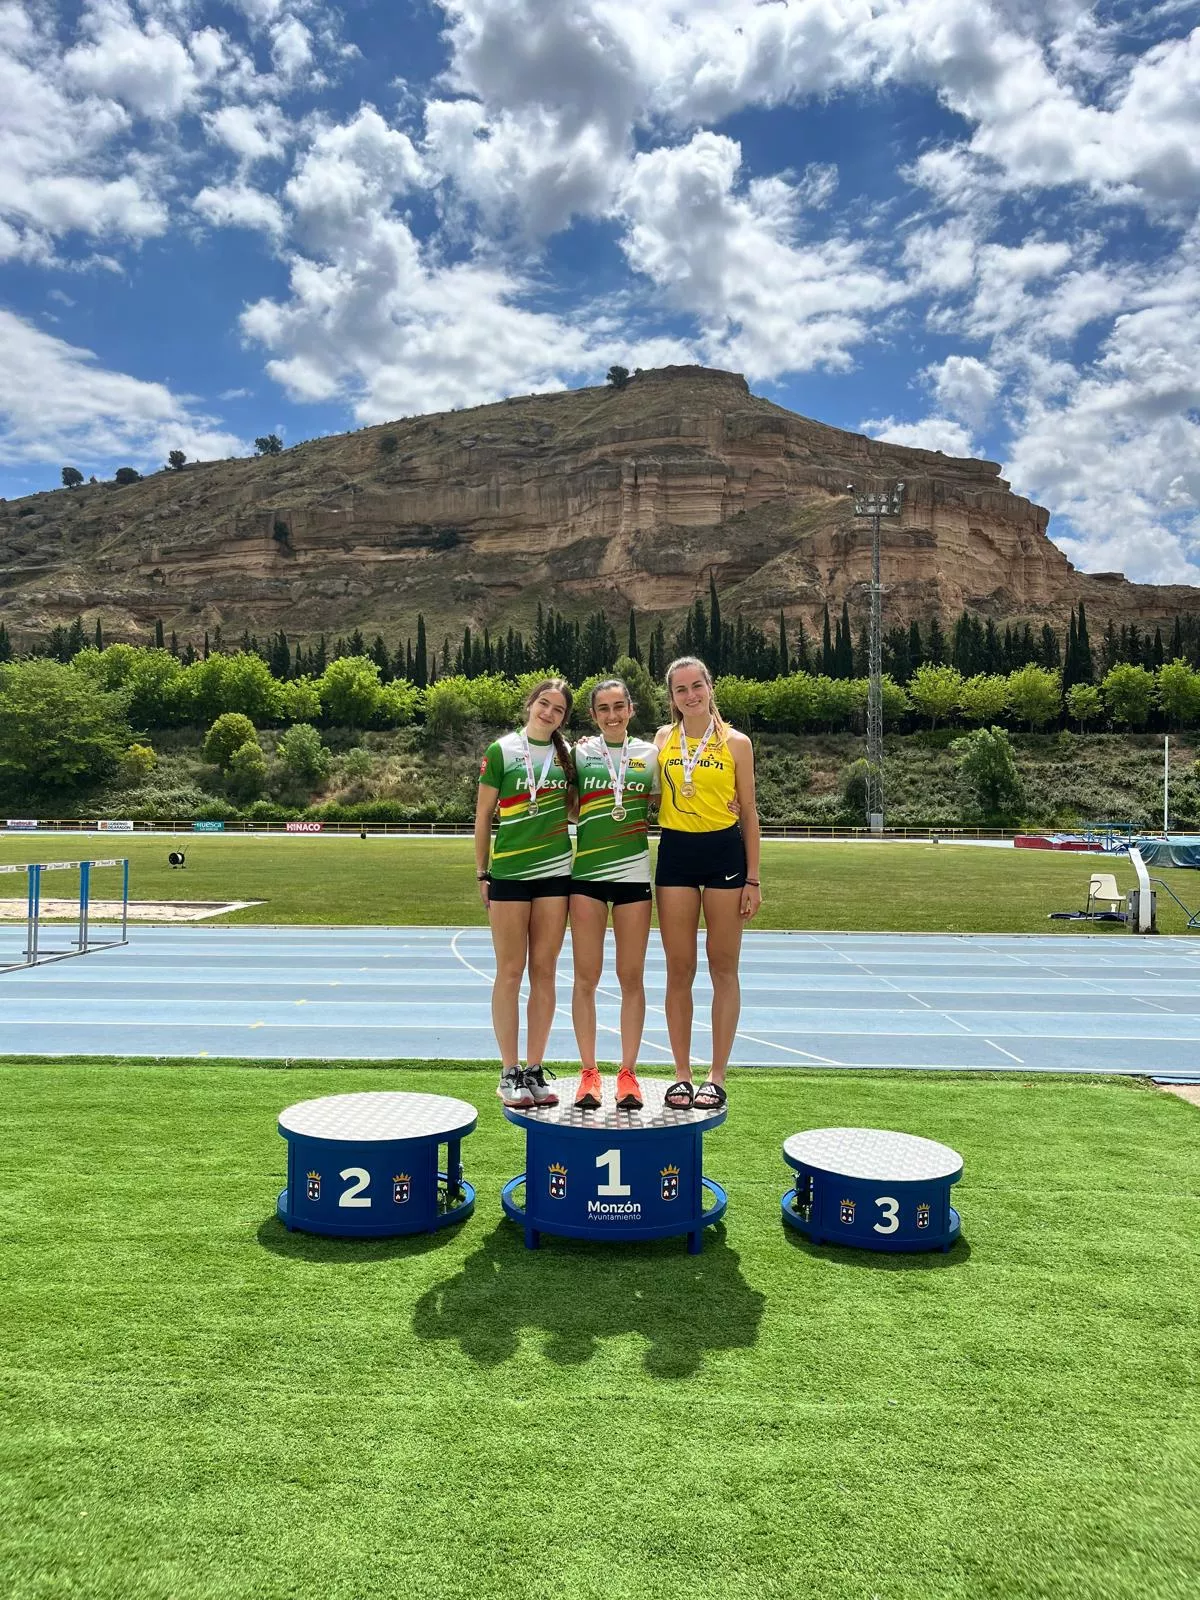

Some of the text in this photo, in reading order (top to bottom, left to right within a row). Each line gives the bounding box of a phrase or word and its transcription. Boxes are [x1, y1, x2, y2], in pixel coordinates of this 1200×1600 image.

[669, 758, 724, 770] SCOIO-71
[515, 777, 568, 791] Hesc
[583, 776, 645, 792] Hueca
[286, 823, 321, 831] KINACO
[595, 1149, 631, 1196] 1
[338, 1167, 372, 1208] 2
[587, 1200, 641, 1213] Monzón
[588, 1213, 641, 1221] Ayuntamiento
[873, 1196, 900, 1234] 3
